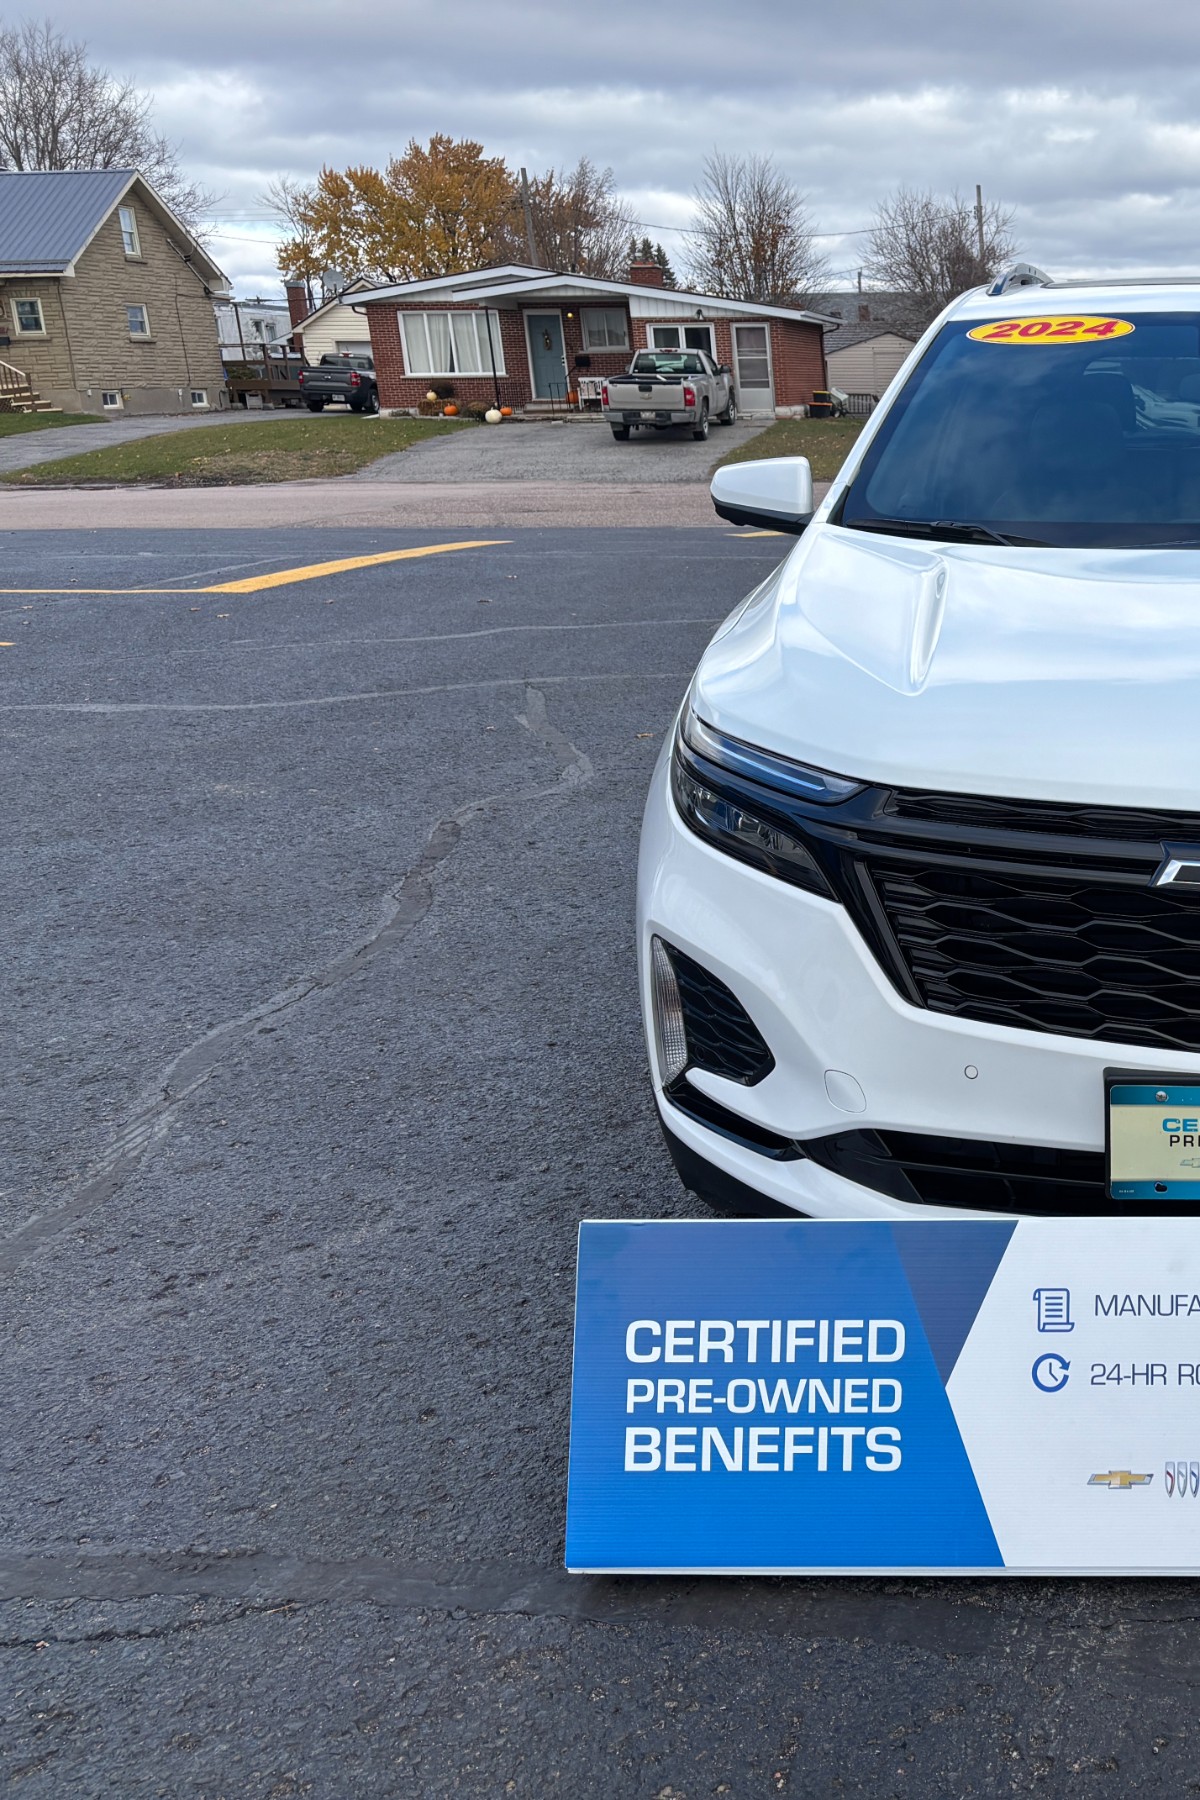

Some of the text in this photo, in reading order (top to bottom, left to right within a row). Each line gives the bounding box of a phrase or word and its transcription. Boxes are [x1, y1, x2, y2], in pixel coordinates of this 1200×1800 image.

[982, 320, 1118, 338] 2024
[625, 1320, 905, 1363] CERTIFIED
[1090, 1364, 1167, 1386] 24-HR
[627, 1379, 902, 1413] PRE-OWNED
[624, 1427, 902, 1472] BENEFITS
